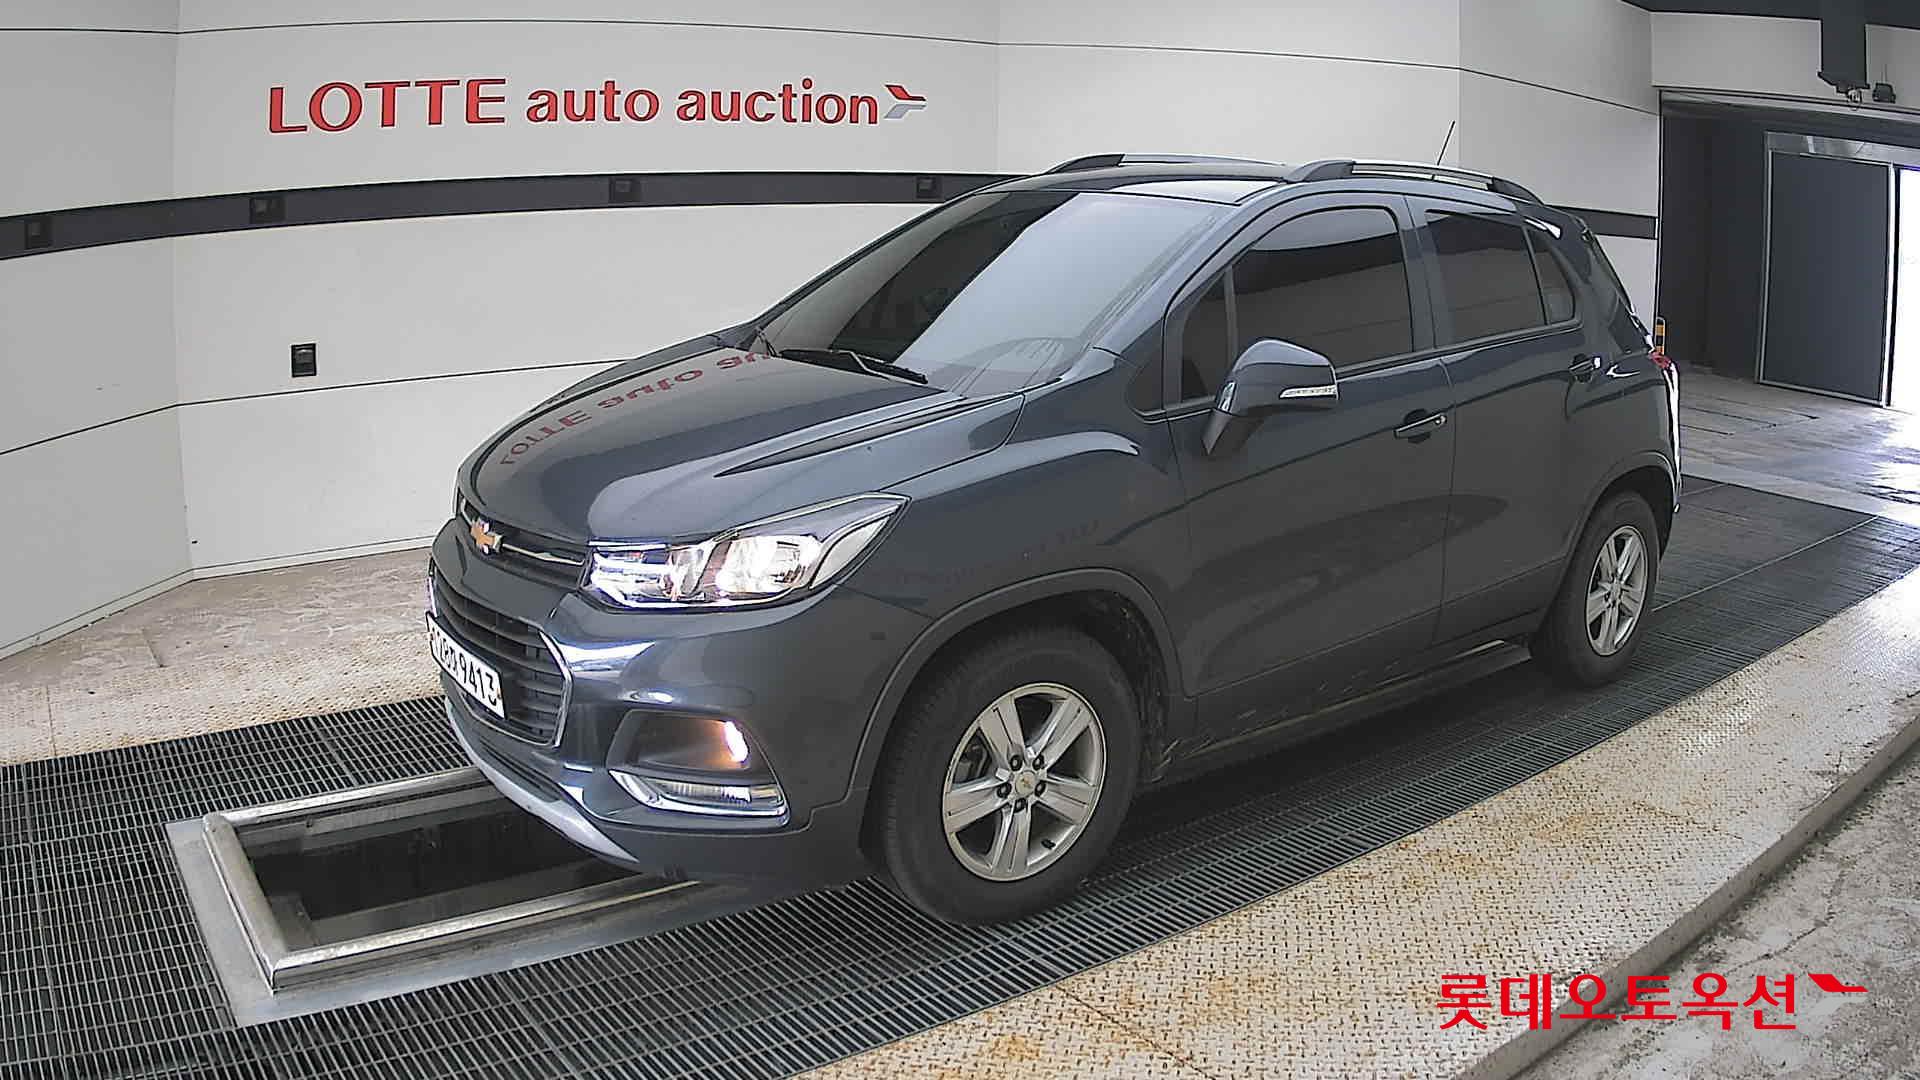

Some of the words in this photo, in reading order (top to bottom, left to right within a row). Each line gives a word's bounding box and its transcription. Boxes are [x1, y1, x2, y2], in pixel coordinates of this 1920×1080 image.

[268, 78, 506, 134] LOTTE
[526, 79, 661, 123] auto
[675, 77, 880, 125] auction
